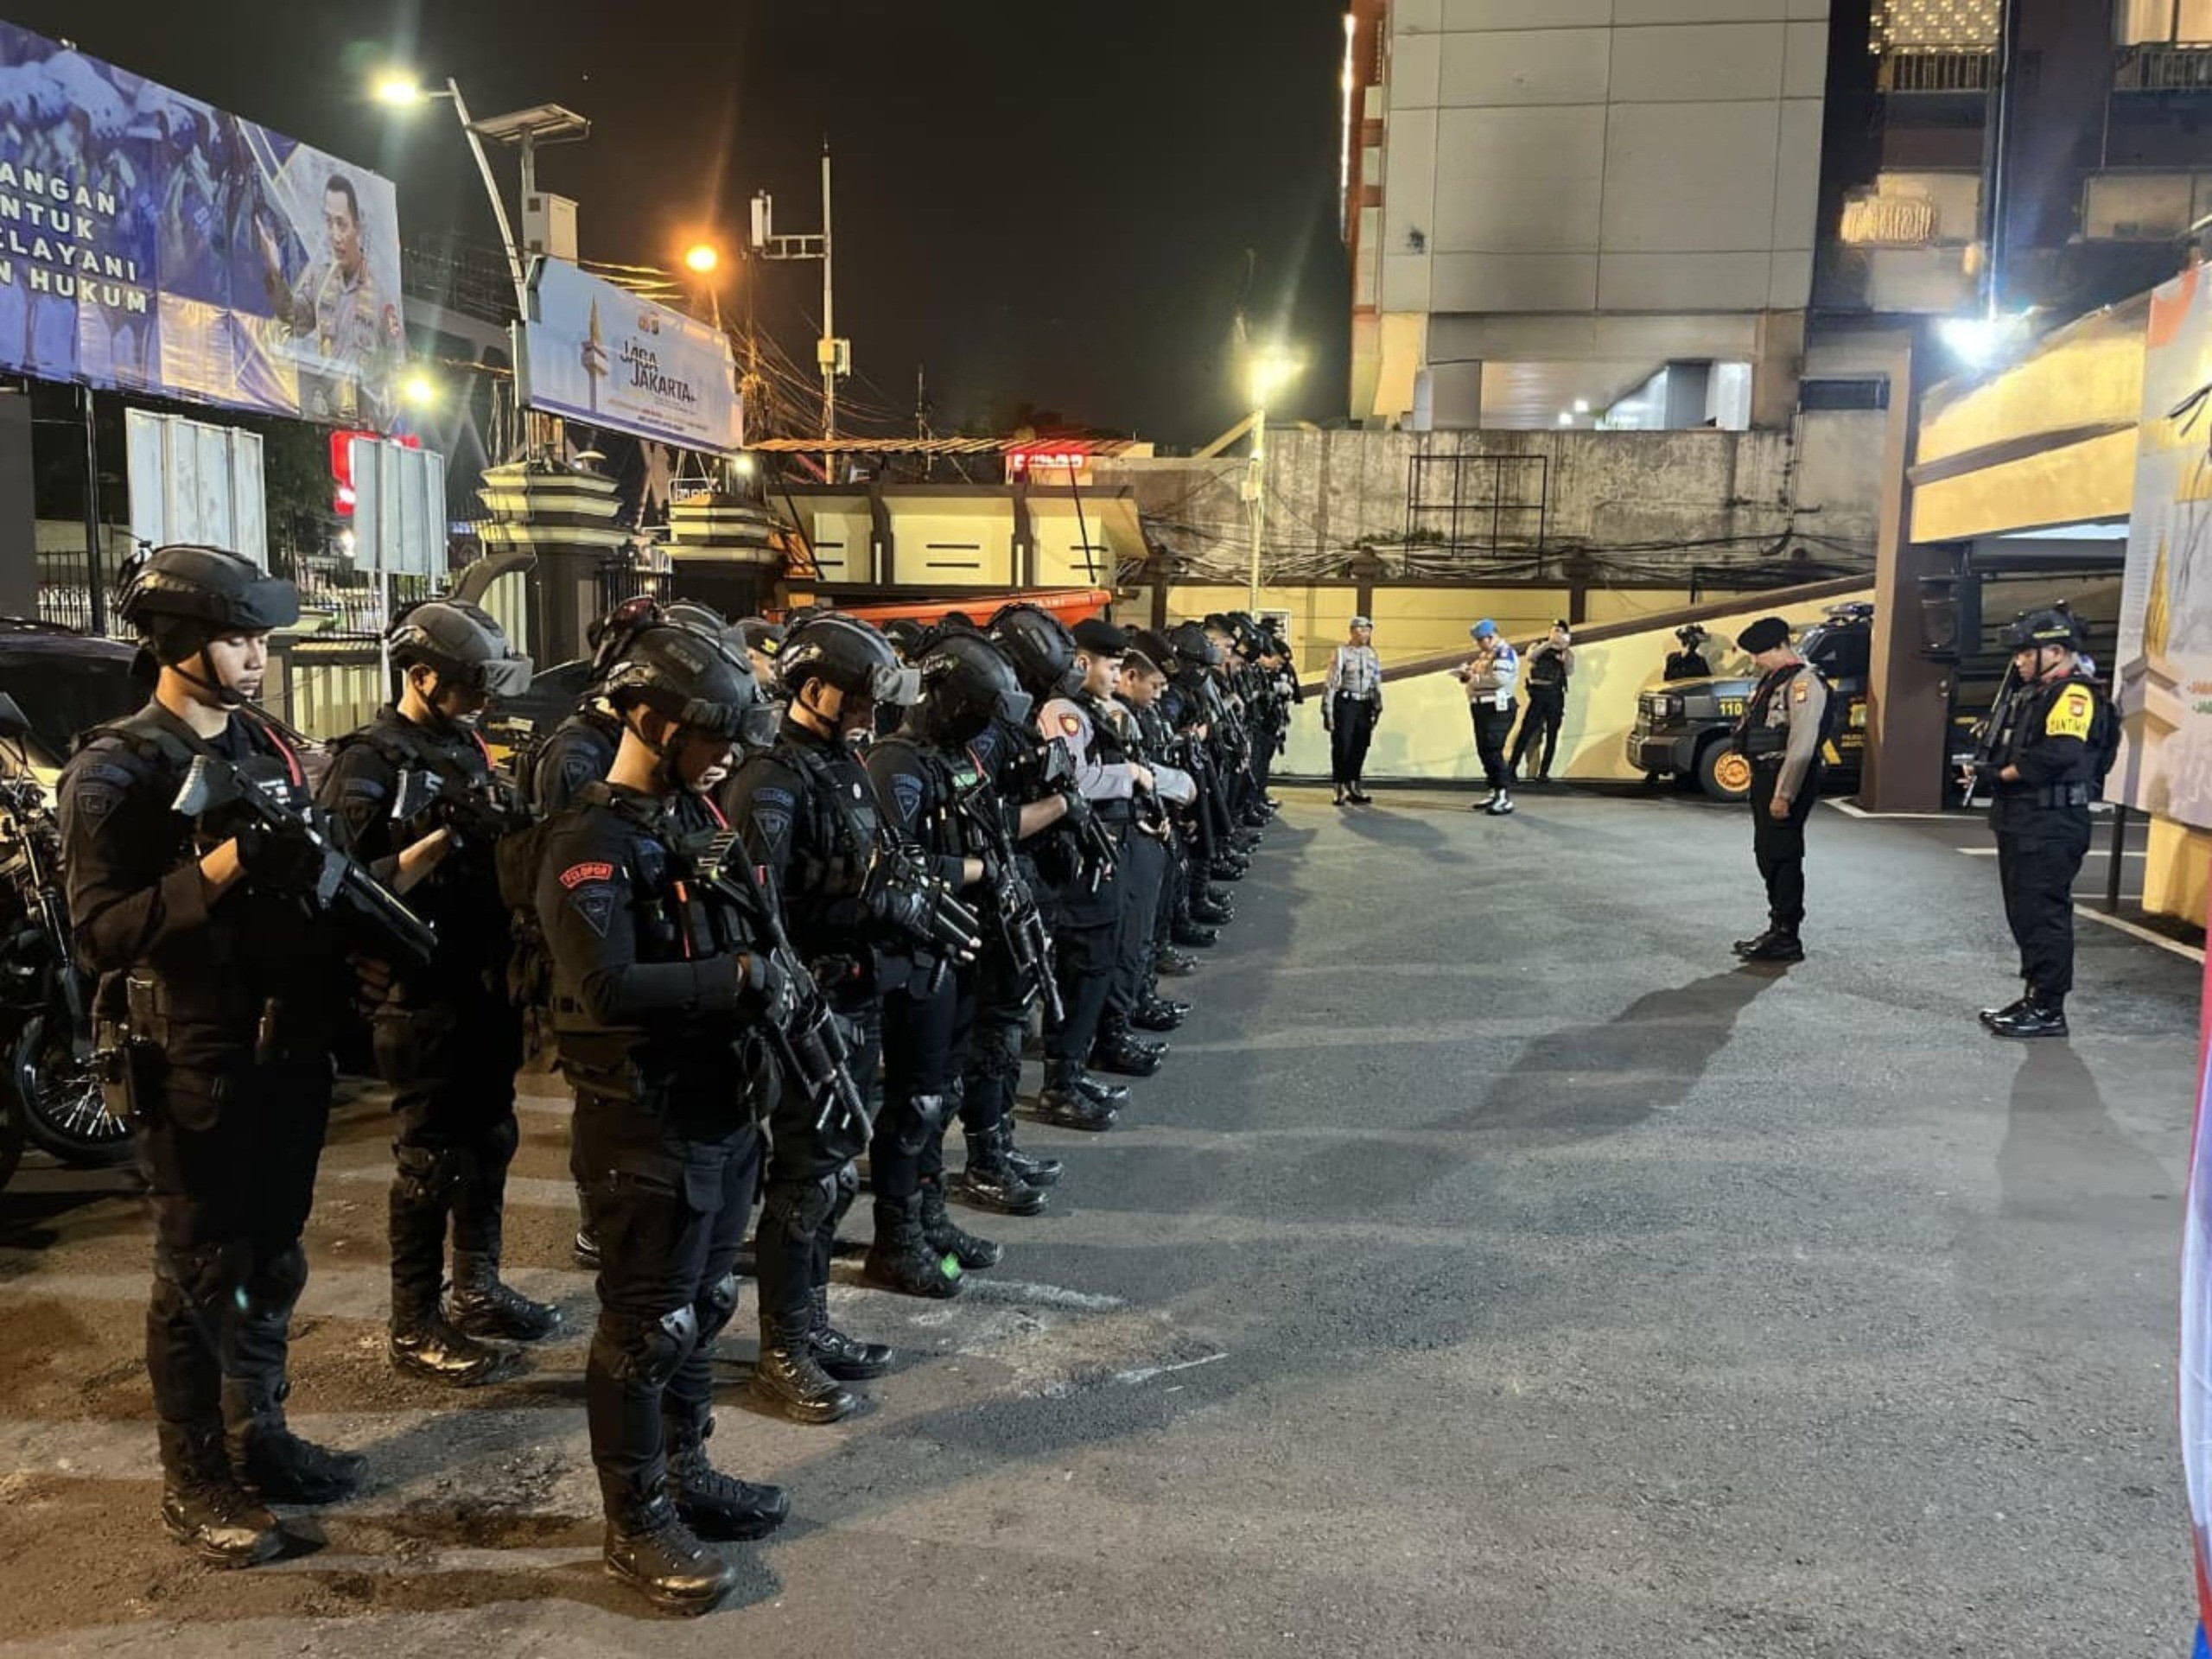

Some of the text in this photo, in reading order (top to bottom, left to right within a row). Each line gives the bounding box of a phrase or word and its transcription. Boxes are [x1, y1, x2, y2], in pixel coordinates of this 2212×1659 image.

[0, 162, 115, 215] ANGAN
[30, 267, 146, 314] HUKUM
[620, 340, 659, 372] JAGA
[1719, 702, 1743, 716] 110
